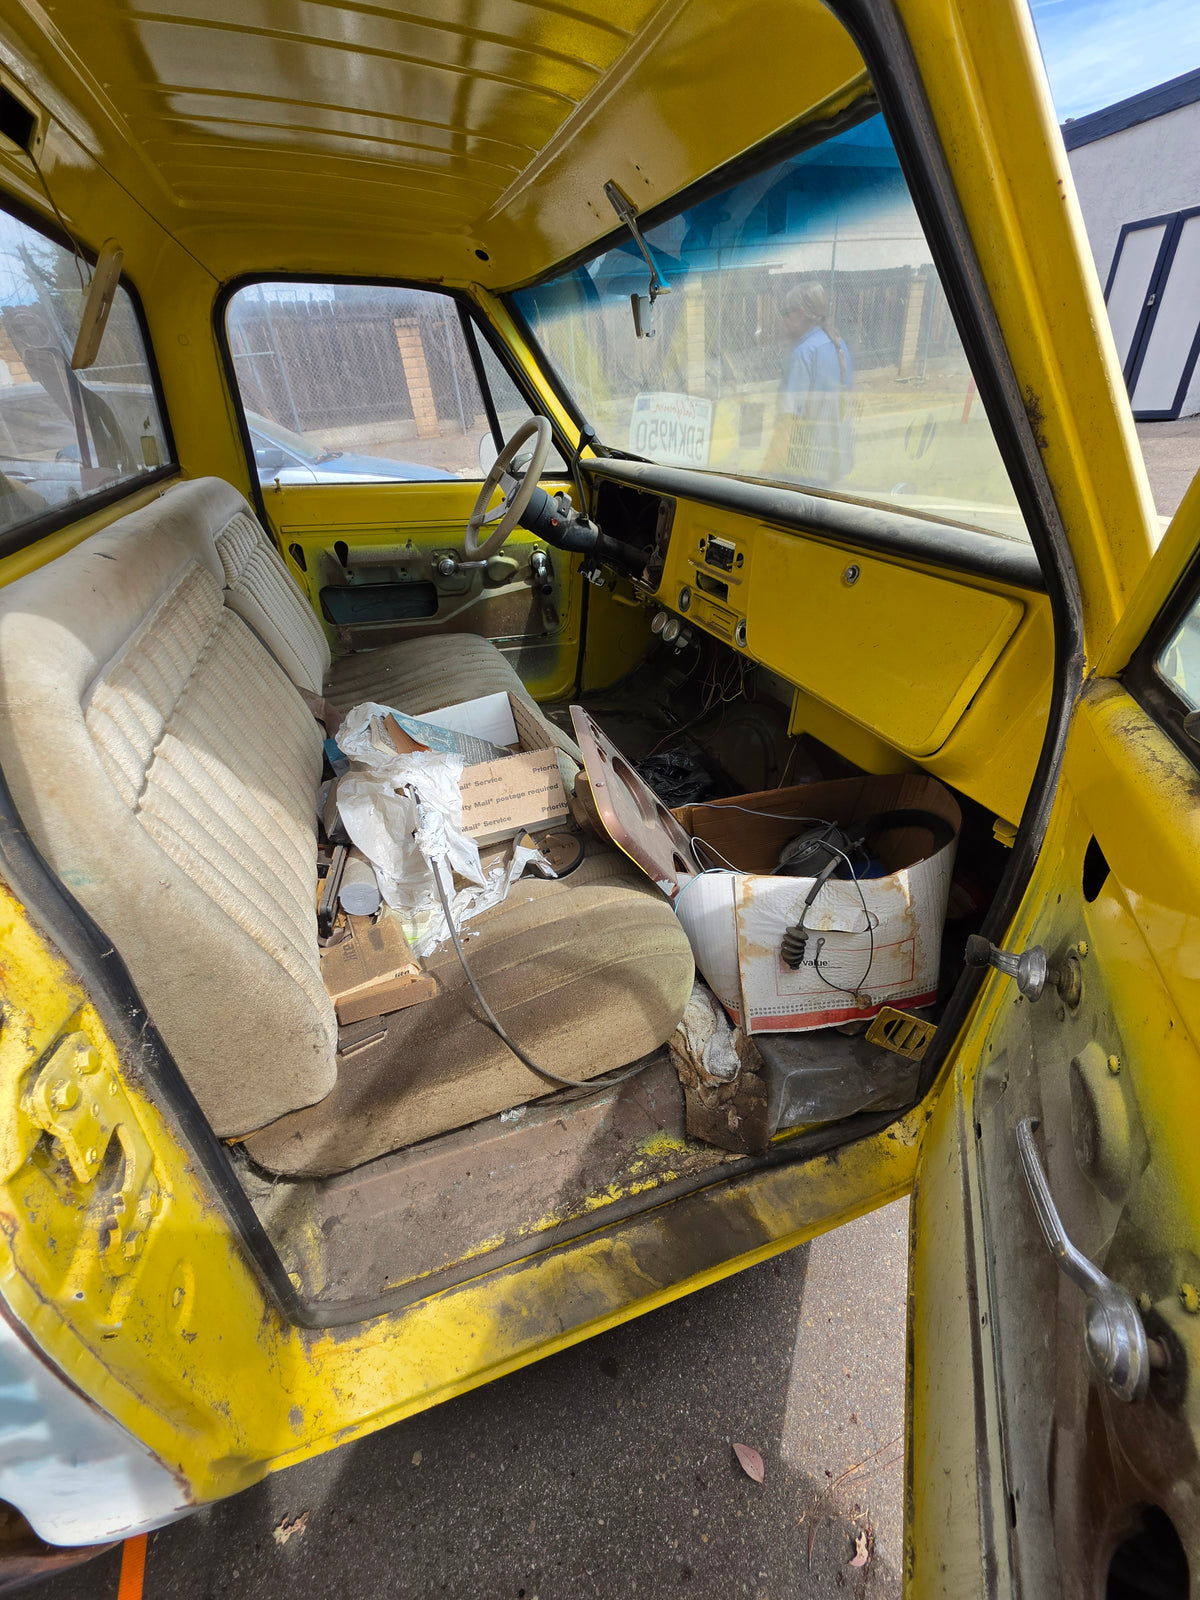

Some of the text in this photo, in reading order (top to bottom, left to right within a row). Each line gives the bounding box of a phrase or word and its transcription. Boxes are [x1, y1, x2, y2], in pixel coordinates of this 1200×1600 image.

[532, 764, 559, 774] Priority
[474, 776, 503, 787] Service
[496, 792, 526, 804] postage
[528, 783, 559, 796] required
[541, 801, 569, 813] Priority
[483, 816, 512, 827] Service
